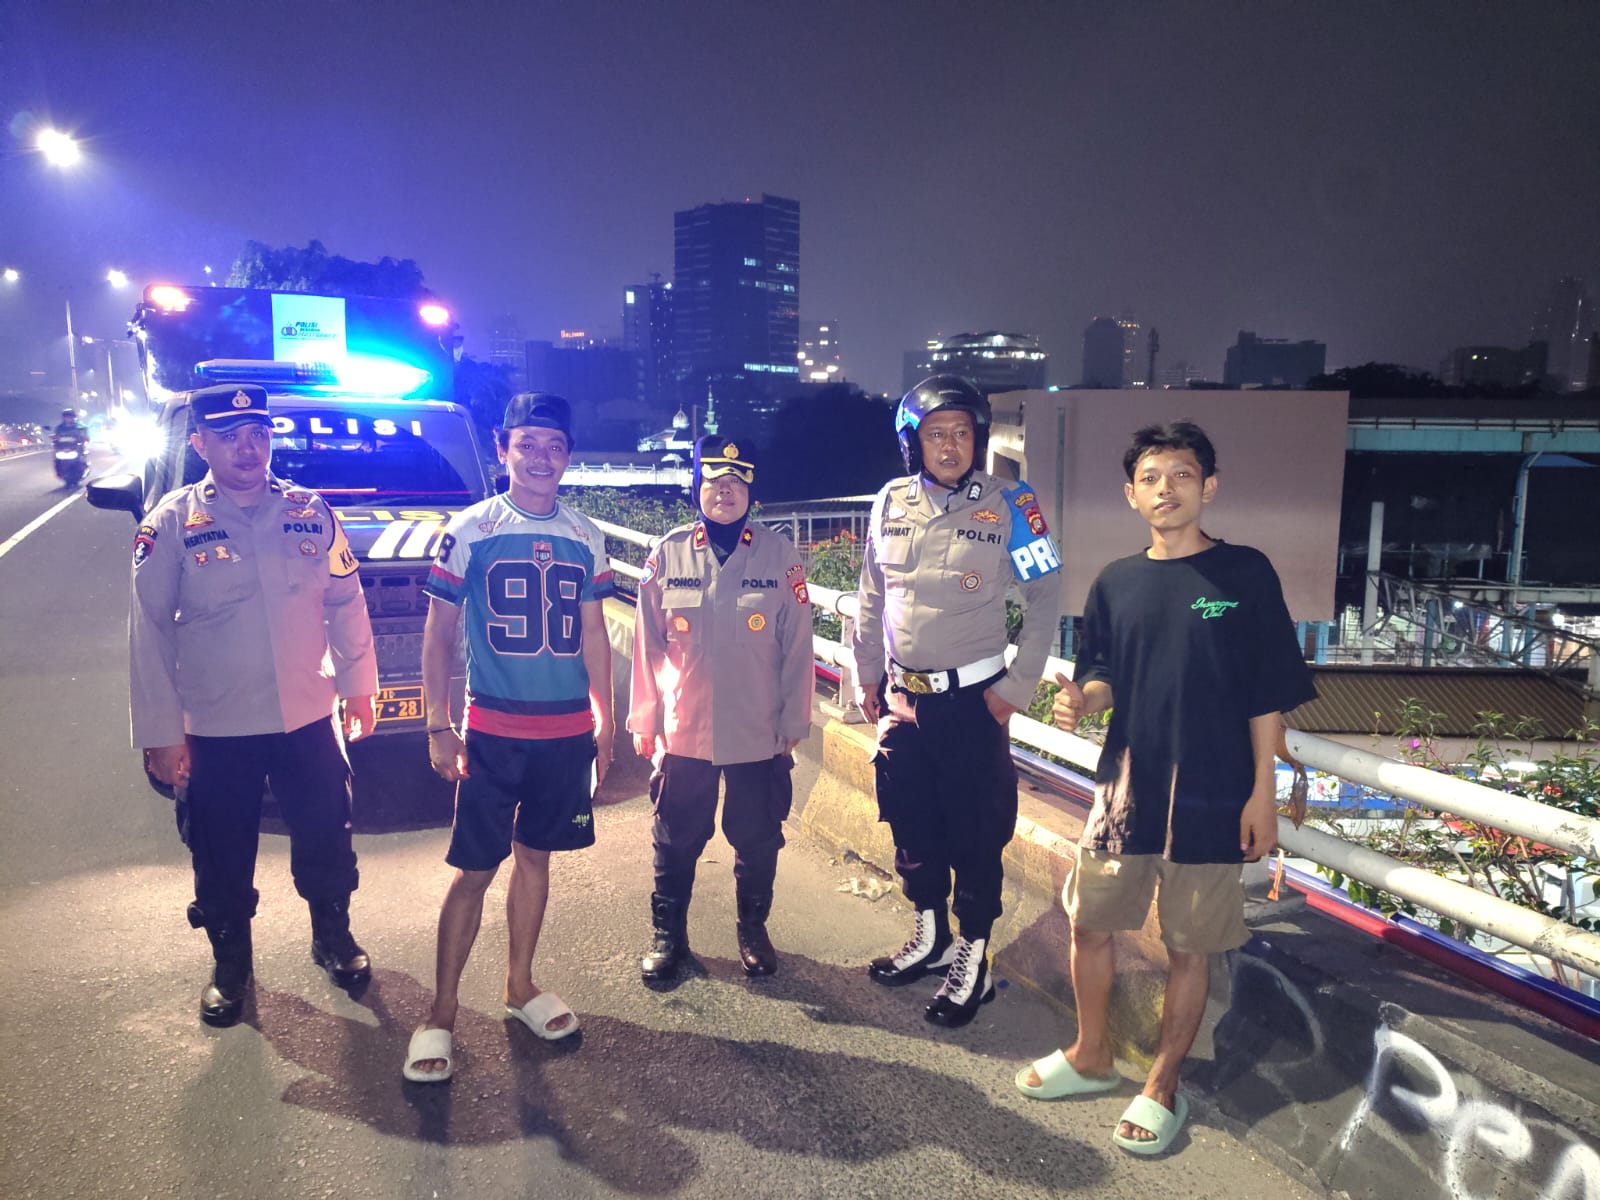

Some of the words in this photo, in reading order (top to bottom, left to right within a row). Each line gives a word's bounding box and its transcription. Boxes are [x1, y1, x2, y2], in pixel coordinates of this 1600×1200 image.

[283, 523, 323, 535] POLRI
[956, 529, 1002, 545] POLRI
[741, 578, 778, 589] POLRI
[485, 560, 587, 656] 98
